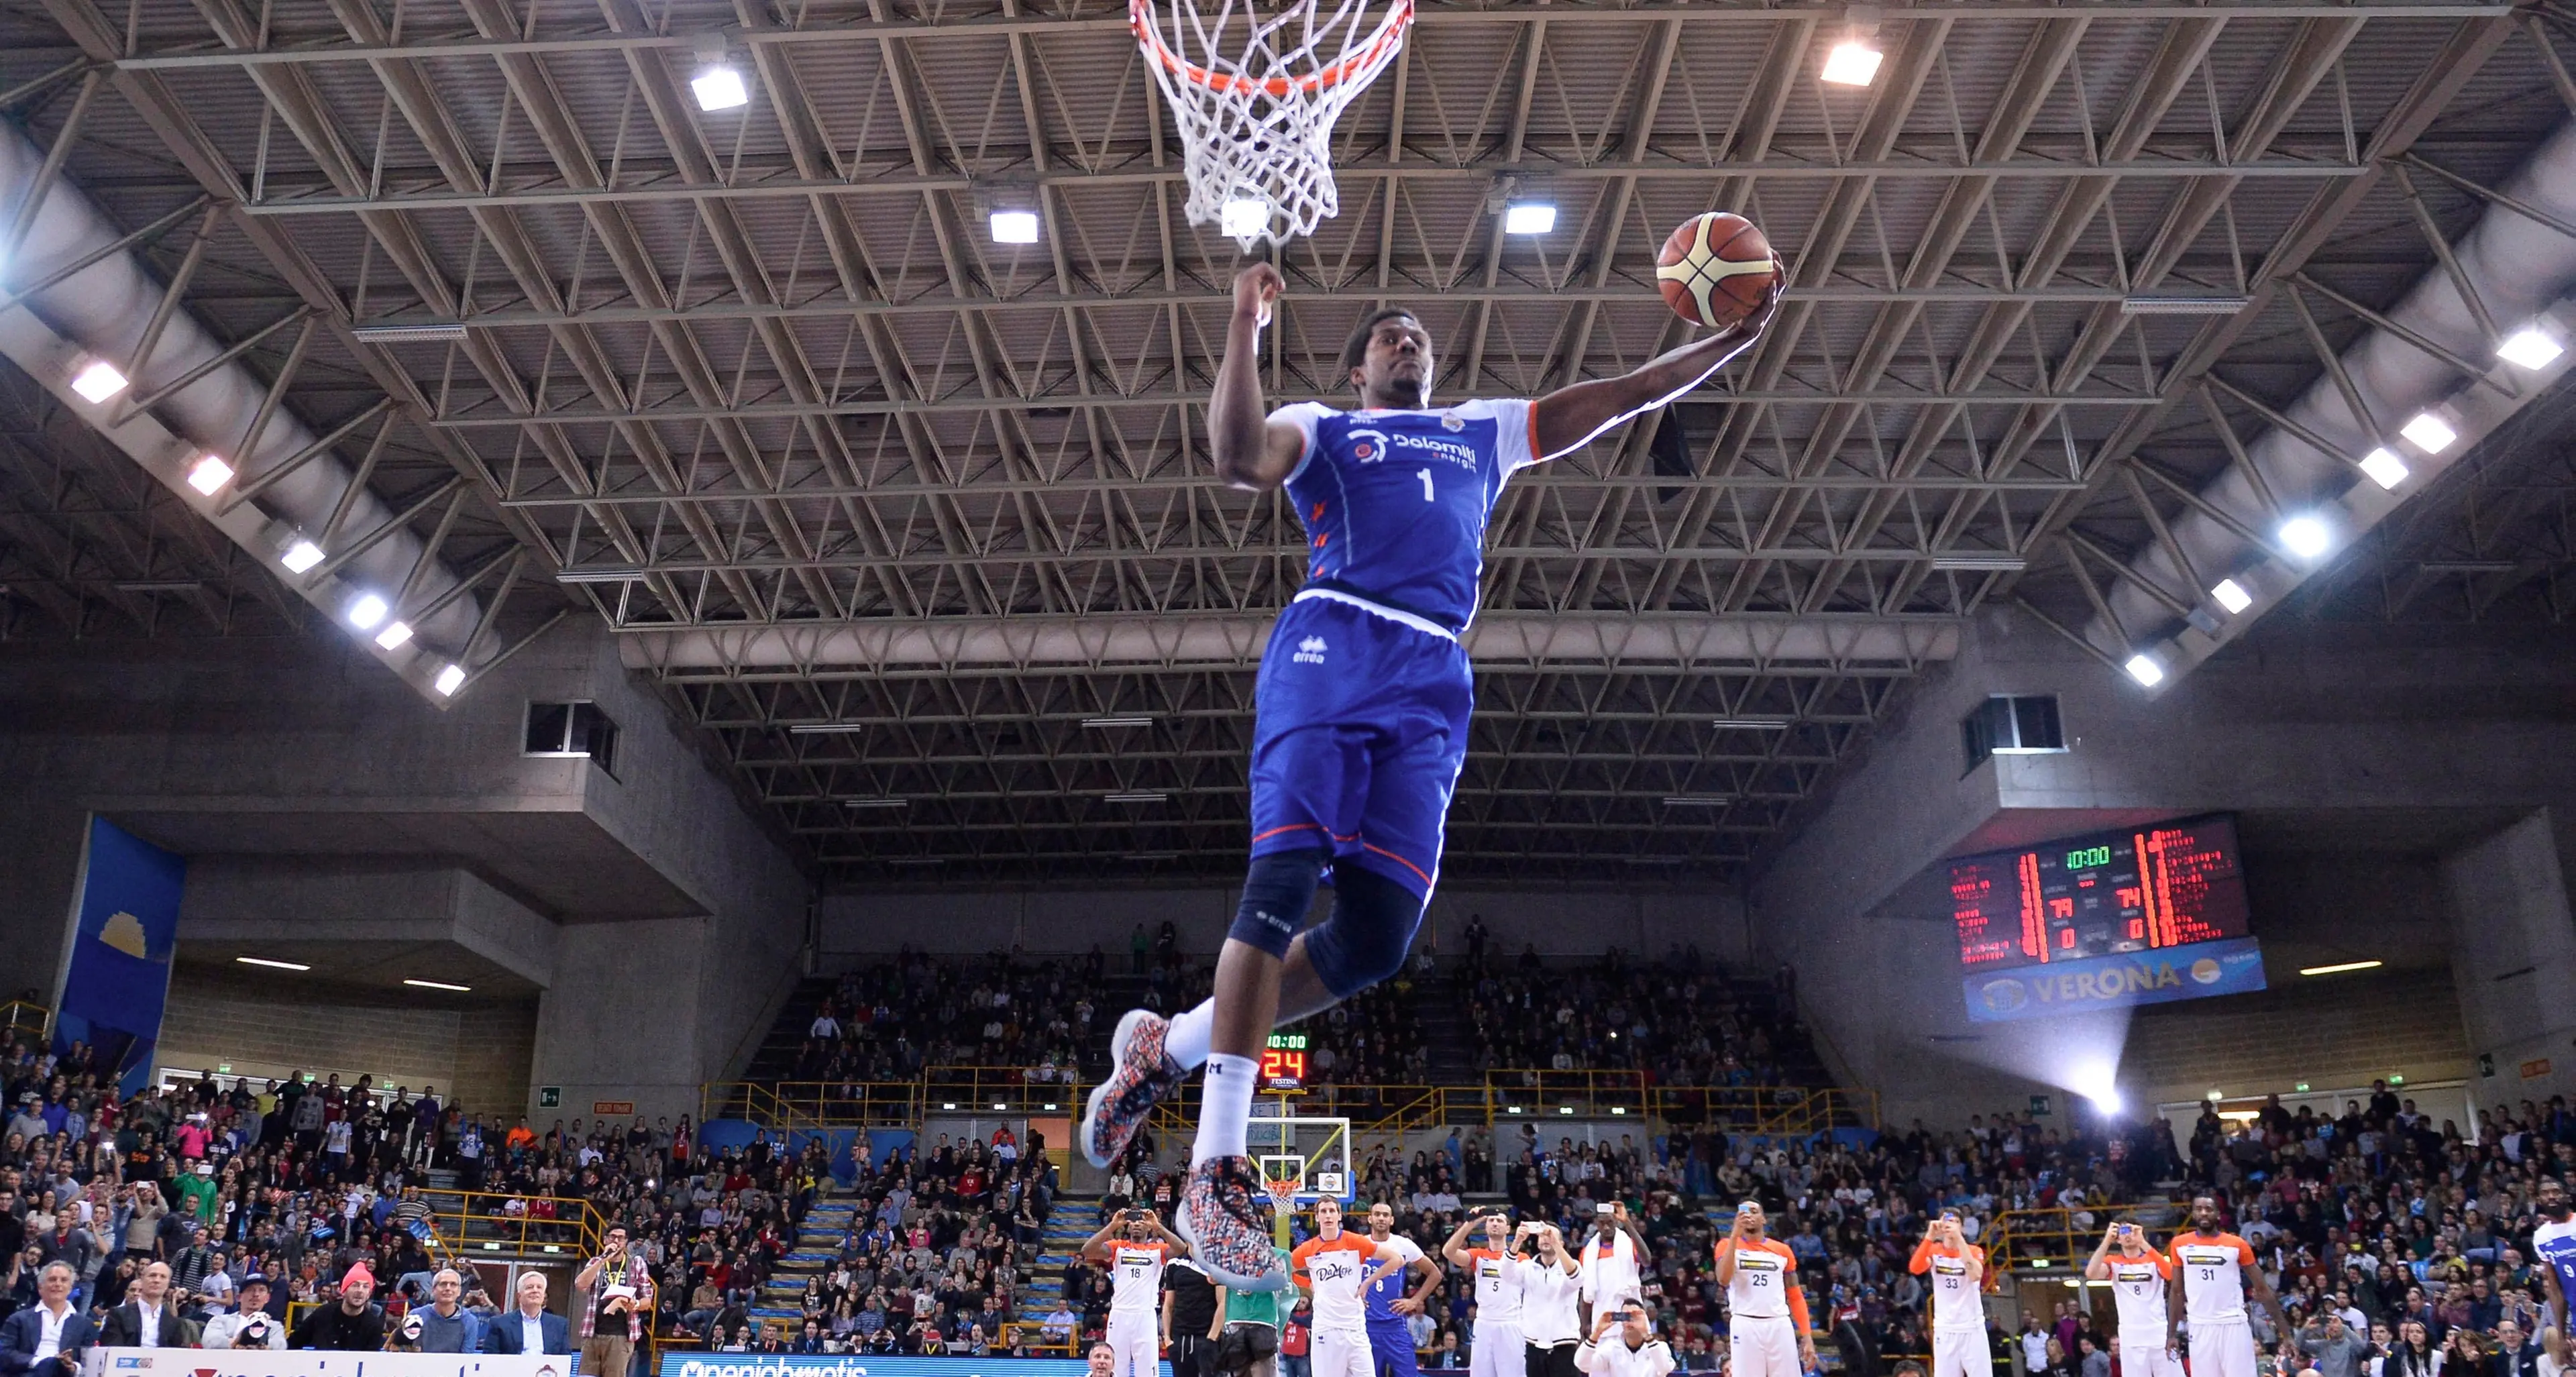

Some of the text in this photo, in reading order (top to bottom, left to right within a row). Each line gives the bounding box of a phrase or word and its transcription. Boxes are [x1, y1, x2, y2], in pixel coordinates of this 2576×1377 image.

[1393, 434, 1476, 464] Dolomiti
[1417, 467, 1434, 502] 1
[2066, 846, 2110, 871] 10:00
[2114, 887, 2141, 908] 74
[2048, 897, 2074, 919] 79
[2033, 962, 2181, 1002] VERONA
[1267, 1035, 1306, 1049] 10:00
[1264, 1052, 1303, 1079] 24
[1130, 1268, 1140, 1278] 18
[2202, 1268, 2214, 1281] 31
[2563, 1264, 2575, 1278] 9
[1376, 1279, 1385, 1292] 8
[1493, 1281, 1499, 1292] 5
[1752, 1274, 1768, 1286] 25
[1945, 1278, 1958, 1289] 33
[2134, 1284, 2141, 1295] 8
